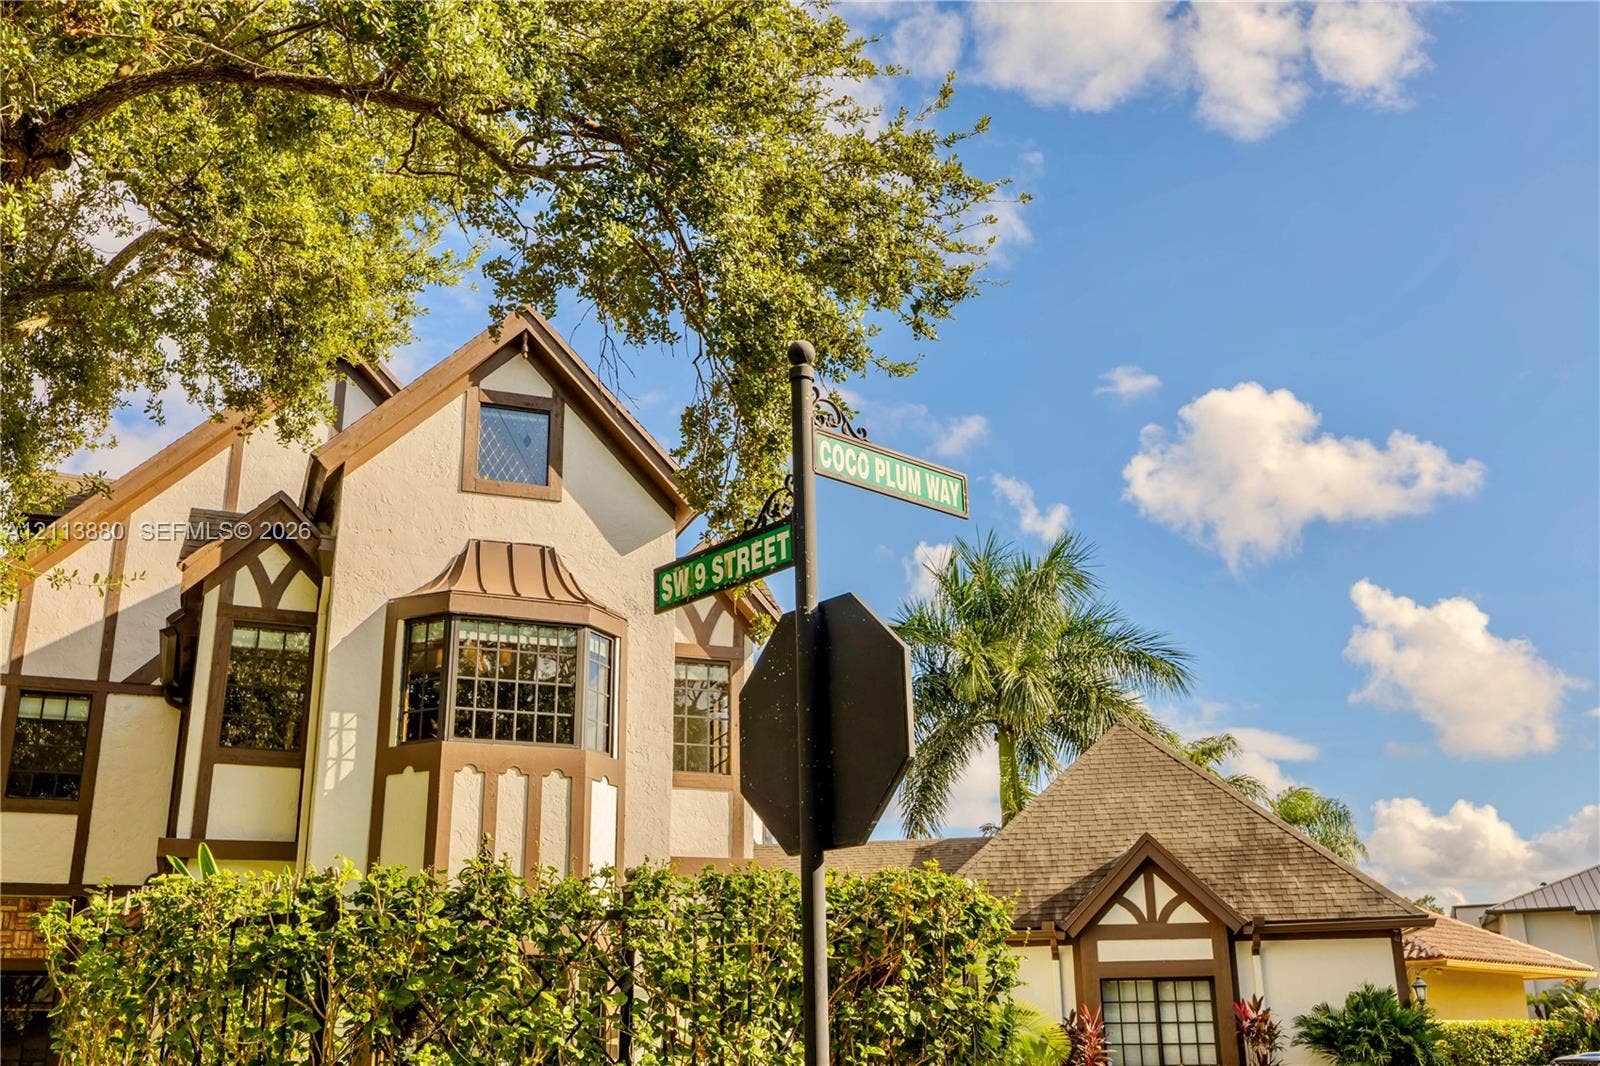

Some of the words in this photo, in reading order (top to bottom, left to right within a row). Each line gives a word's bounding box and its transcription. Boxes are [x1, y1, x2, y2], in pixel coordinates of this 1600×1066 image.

[819, 440, 870, 480] COCO
[874, 457, 922, 496] PLUM
[925, 473, 961, 507] WAY
[661, 566, 690, 602] SW
[694, 562, 706, 590] 9
[711, 530, 790, 584] STREET
